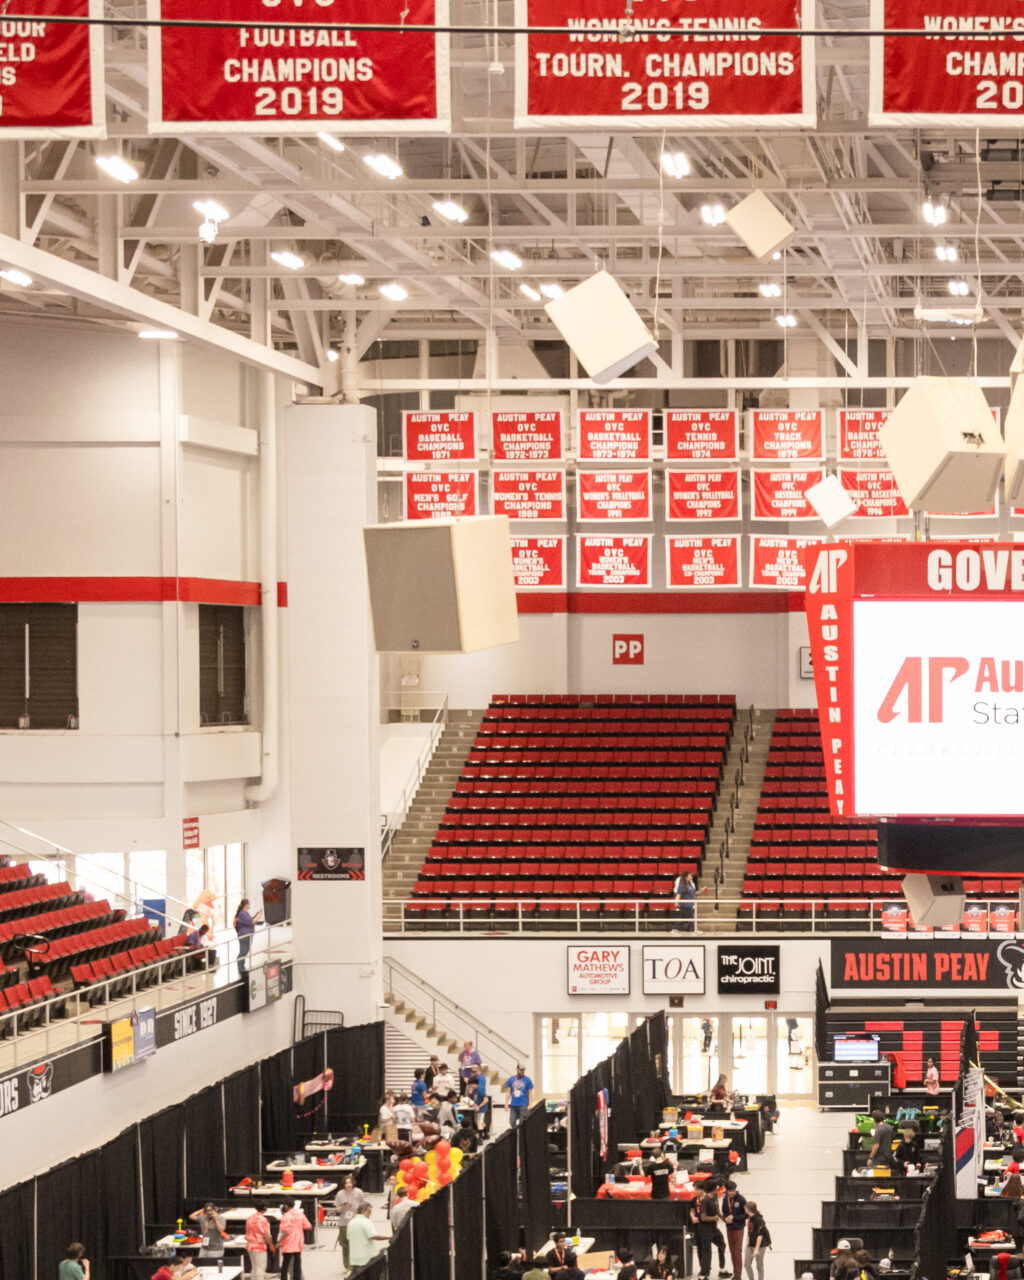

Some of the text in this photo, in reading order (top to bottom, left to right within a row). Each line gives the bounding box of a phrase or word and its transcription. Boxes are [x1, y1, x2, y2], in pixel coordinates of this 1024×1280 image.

[567, 17, 762, 42] WOMEN'S TENNIS
[239, 26, 356, 47] FOOTBALL
[223, 58, 373, 83] CHAMPIONS
[536, 53, 794, 77] TOURN. CHAMPIONS
[254, 87, 344, 115] 2019
[621, 82, 710, 110] 2019
[585, 413, 643, 421] AUSTIN PEAY
[672, 413, 729, 421] AUSTIN PEAY
[431, 424, 449, 432] OVC
[518, 423, 536, 431] OVC
[692, 423, 710, 431] OVC
[774, 432, 801, 440] TRACK
[417, 442, 464, 450] CHAMPIONS
[503, 442, 550, 450] CHAMPIONS
[615, 640, 642, 658] PP
[820, 604, 844, 815] AUSTIN PEAY
[577, 951, 620, 962] GARY
[720, 956, 738, 965] THE
[573, 964, 624, 972] MATHEWS
[645, 958, 700, 979] TOA
[844, 952, 990, 982] AUSTIN PEAY
[720, 975, 775, 984] chiropractic
[174, 1005, 196, 1039] SINCE
